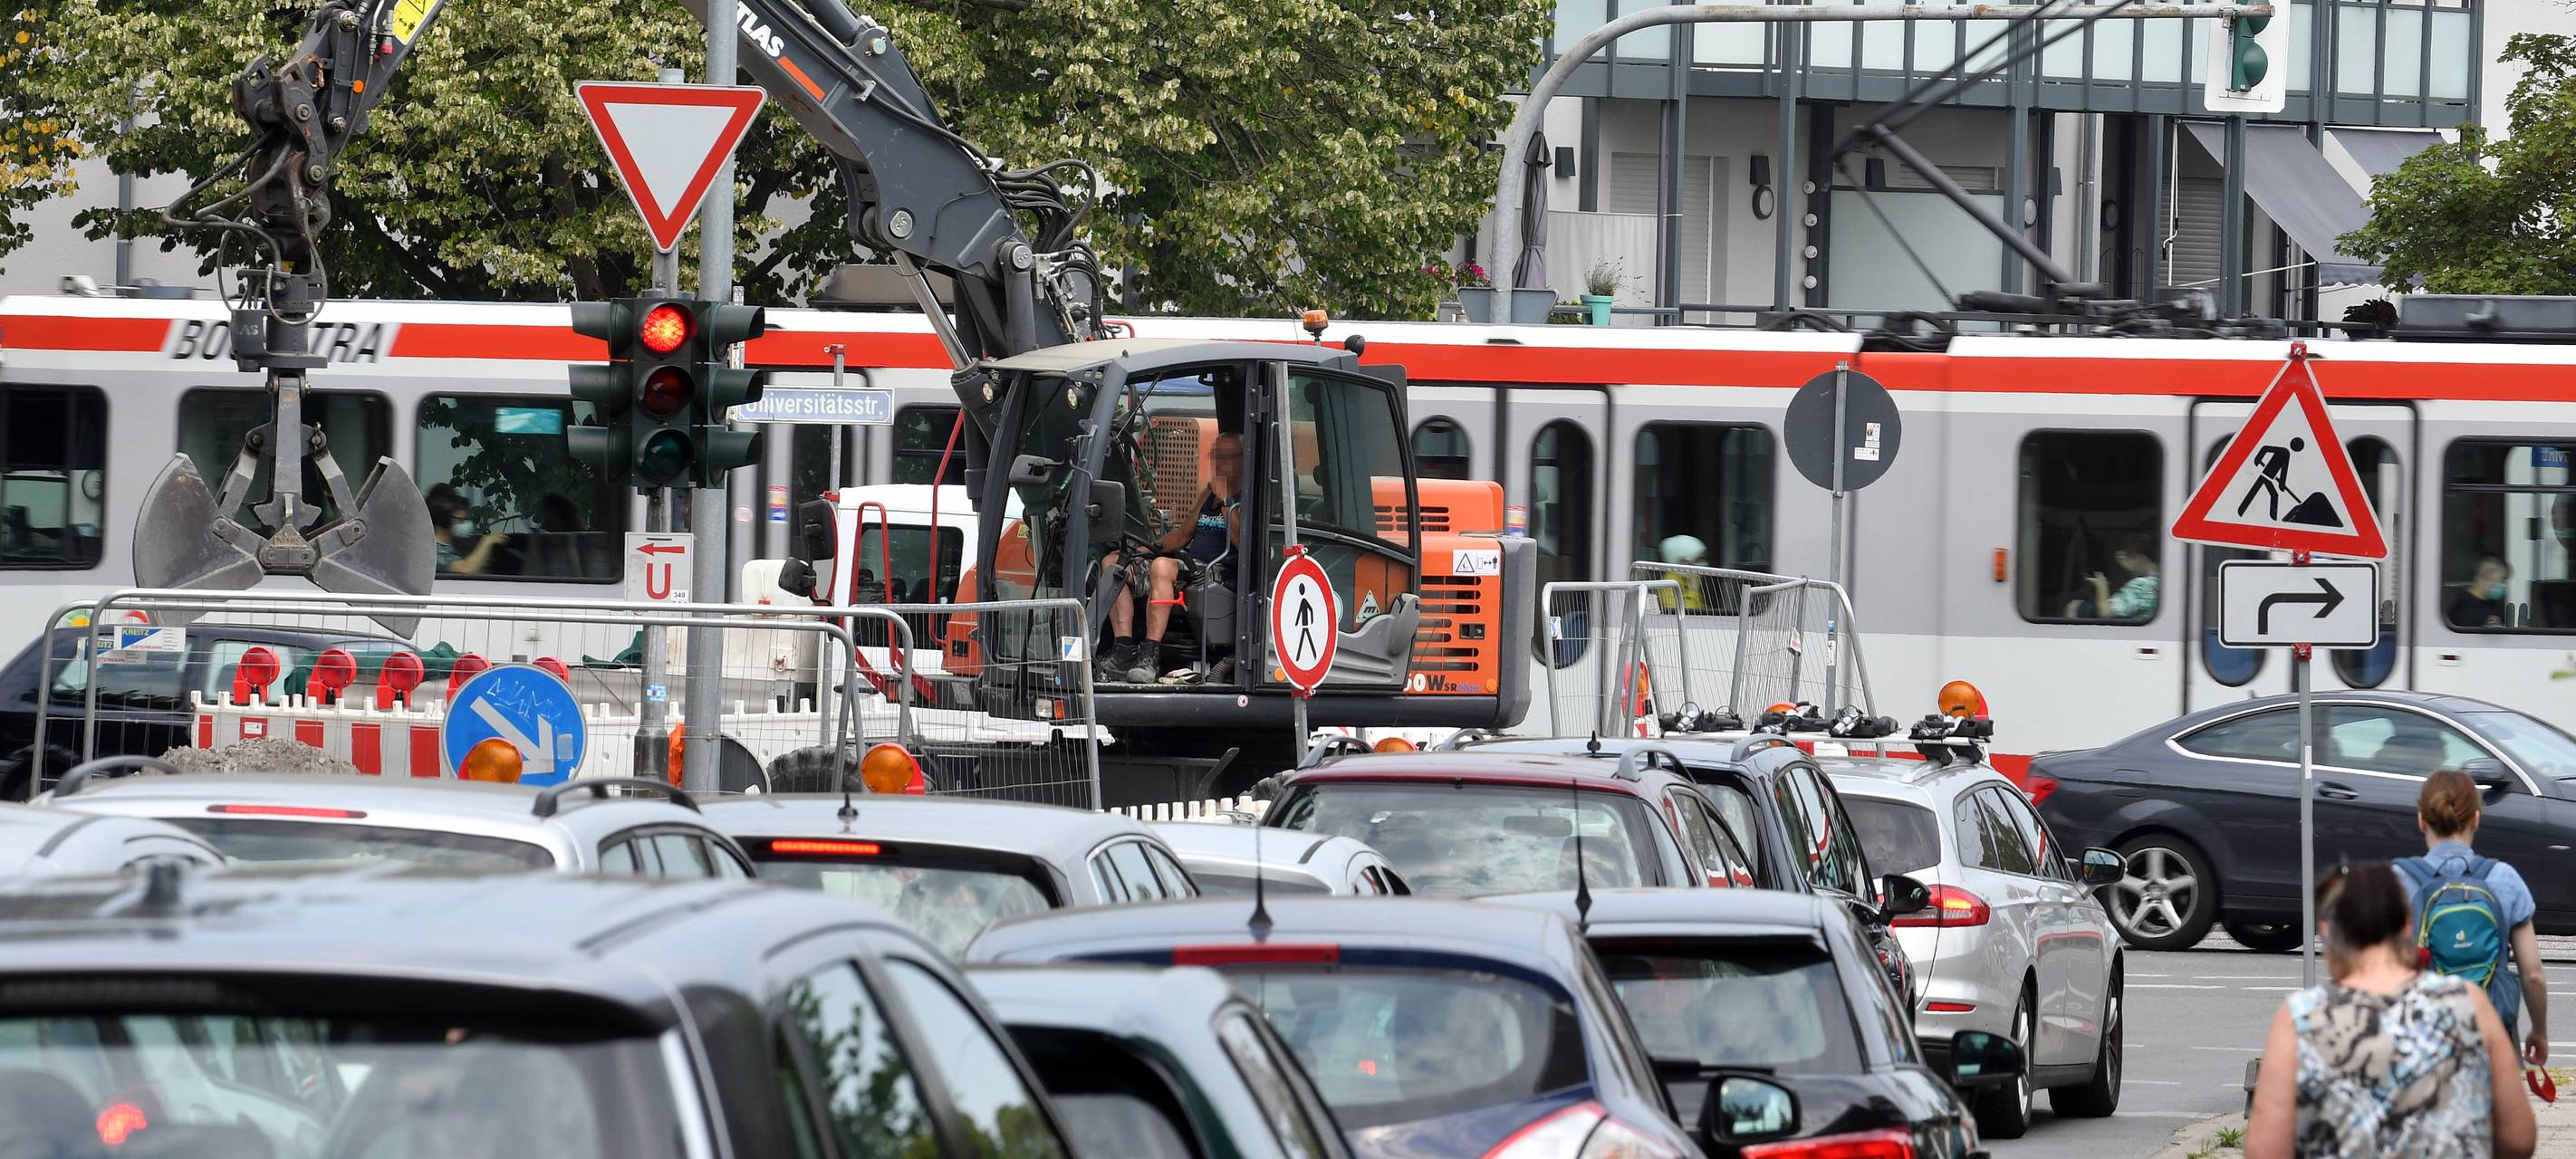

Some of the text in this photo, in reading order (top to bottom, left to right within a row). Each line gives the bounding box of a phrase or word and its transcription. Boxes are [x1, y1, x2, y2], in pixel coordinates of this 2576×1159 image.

[736, 0, 785, 57] TLAS
[170, 320, 384, 363] BOTRA
[646, 562, 671, 600] U
[122, 627, 150, 636] KREITZ
